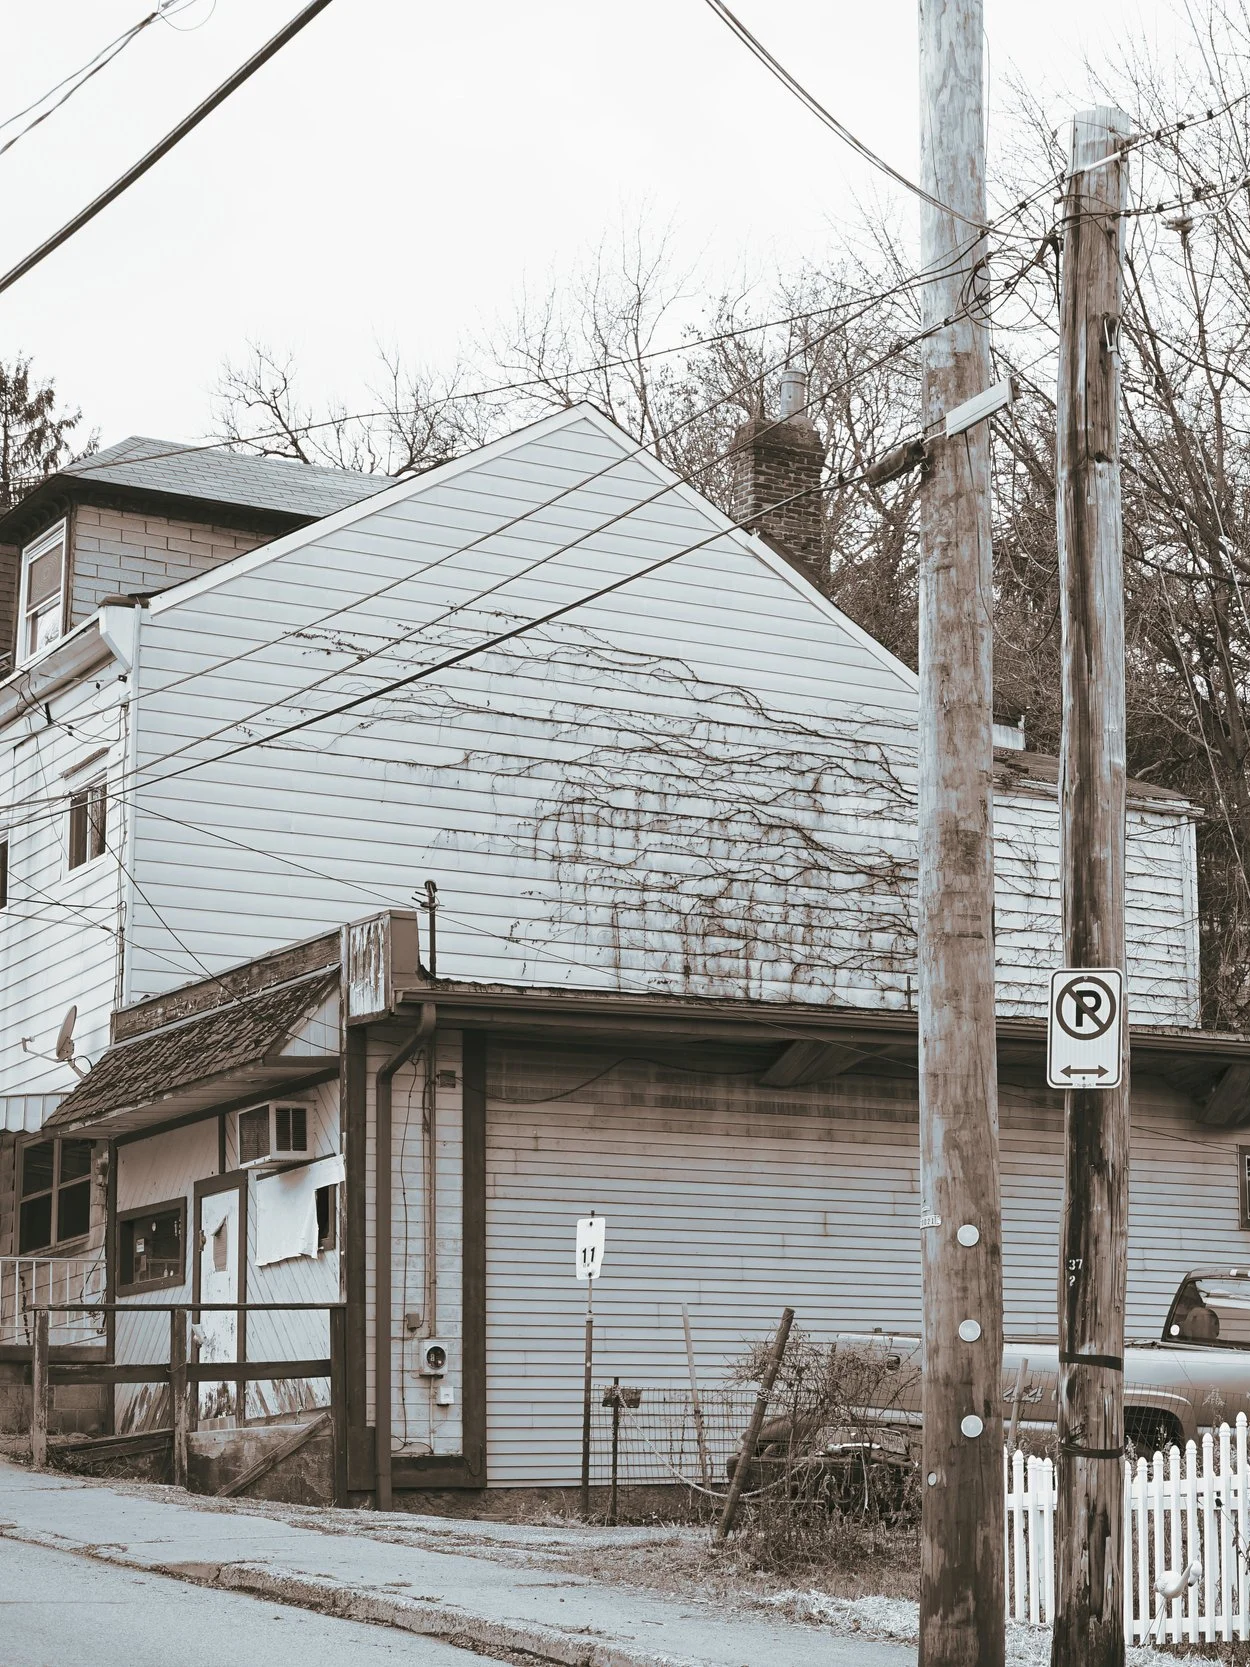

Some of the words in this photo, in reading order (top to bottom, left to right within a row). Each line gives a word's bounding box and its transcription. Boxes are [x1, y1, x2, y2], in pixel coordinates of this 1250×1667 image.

[1076, 990, 1102, 1027] P
[582, 1246, 595, 1264] 11
[1068, 1258, 1083, 1271] 37
